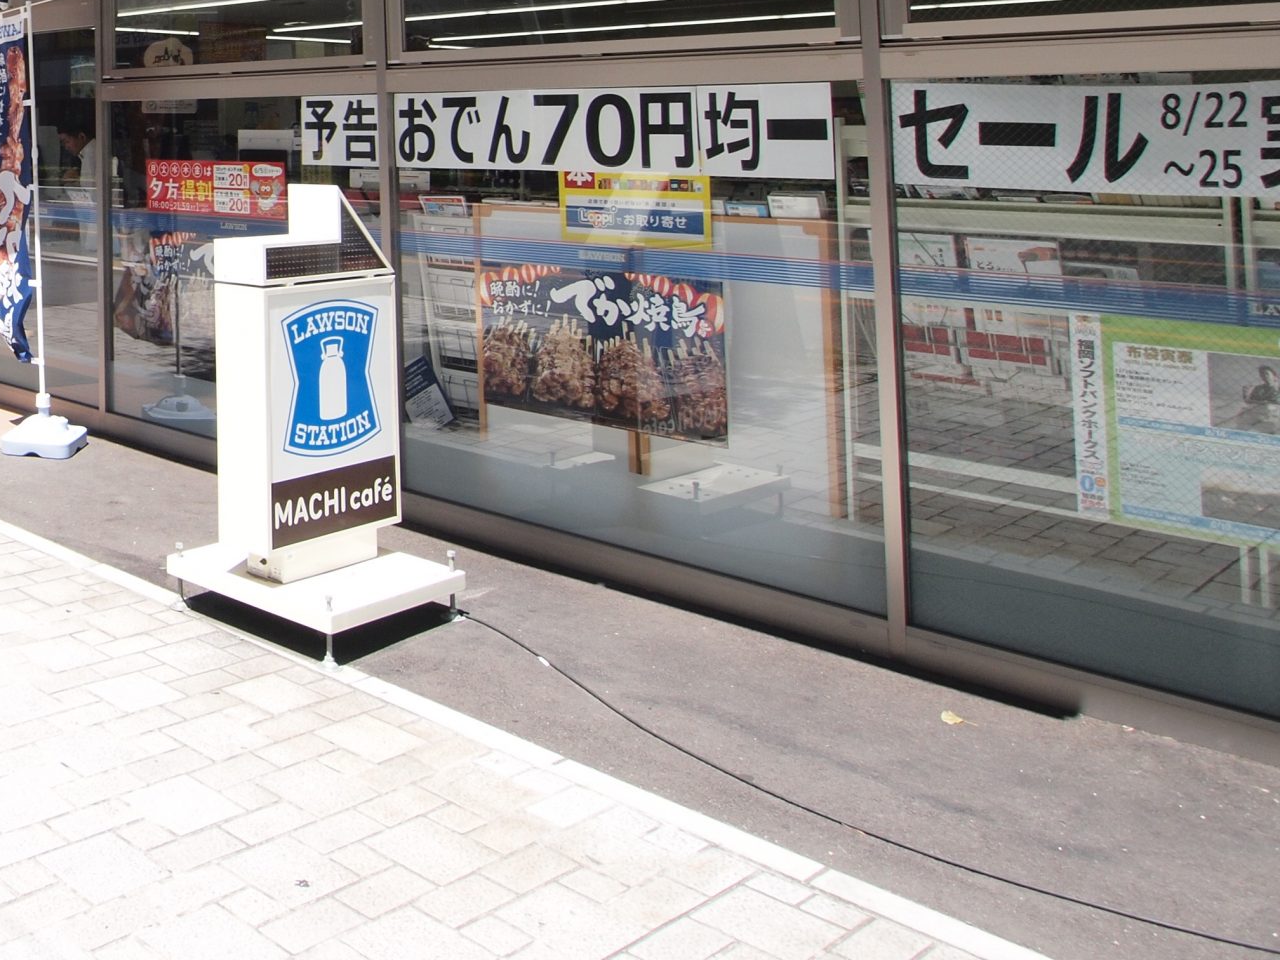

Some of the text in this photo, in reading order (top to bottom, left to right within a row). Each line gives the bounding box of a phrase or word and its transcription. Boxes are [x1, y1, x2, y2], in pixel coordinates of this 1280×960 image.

[1160, 90, 1249, 137] 8/22
[304, 89, 1149, 184] 予告 おでん70円均一 セール
[150, 177, 212, 202] 夕方得割
[489, 280, 540, 297] 晩酌に!
[549, 275, 705, 338] でか焼鳥
[291, 310, 370, 345] LAWSON
[492, 300, 551, 318] おかずに!
[294, 409, 372, 446] STATION
[274, 476, 393, 530] MACHI café
